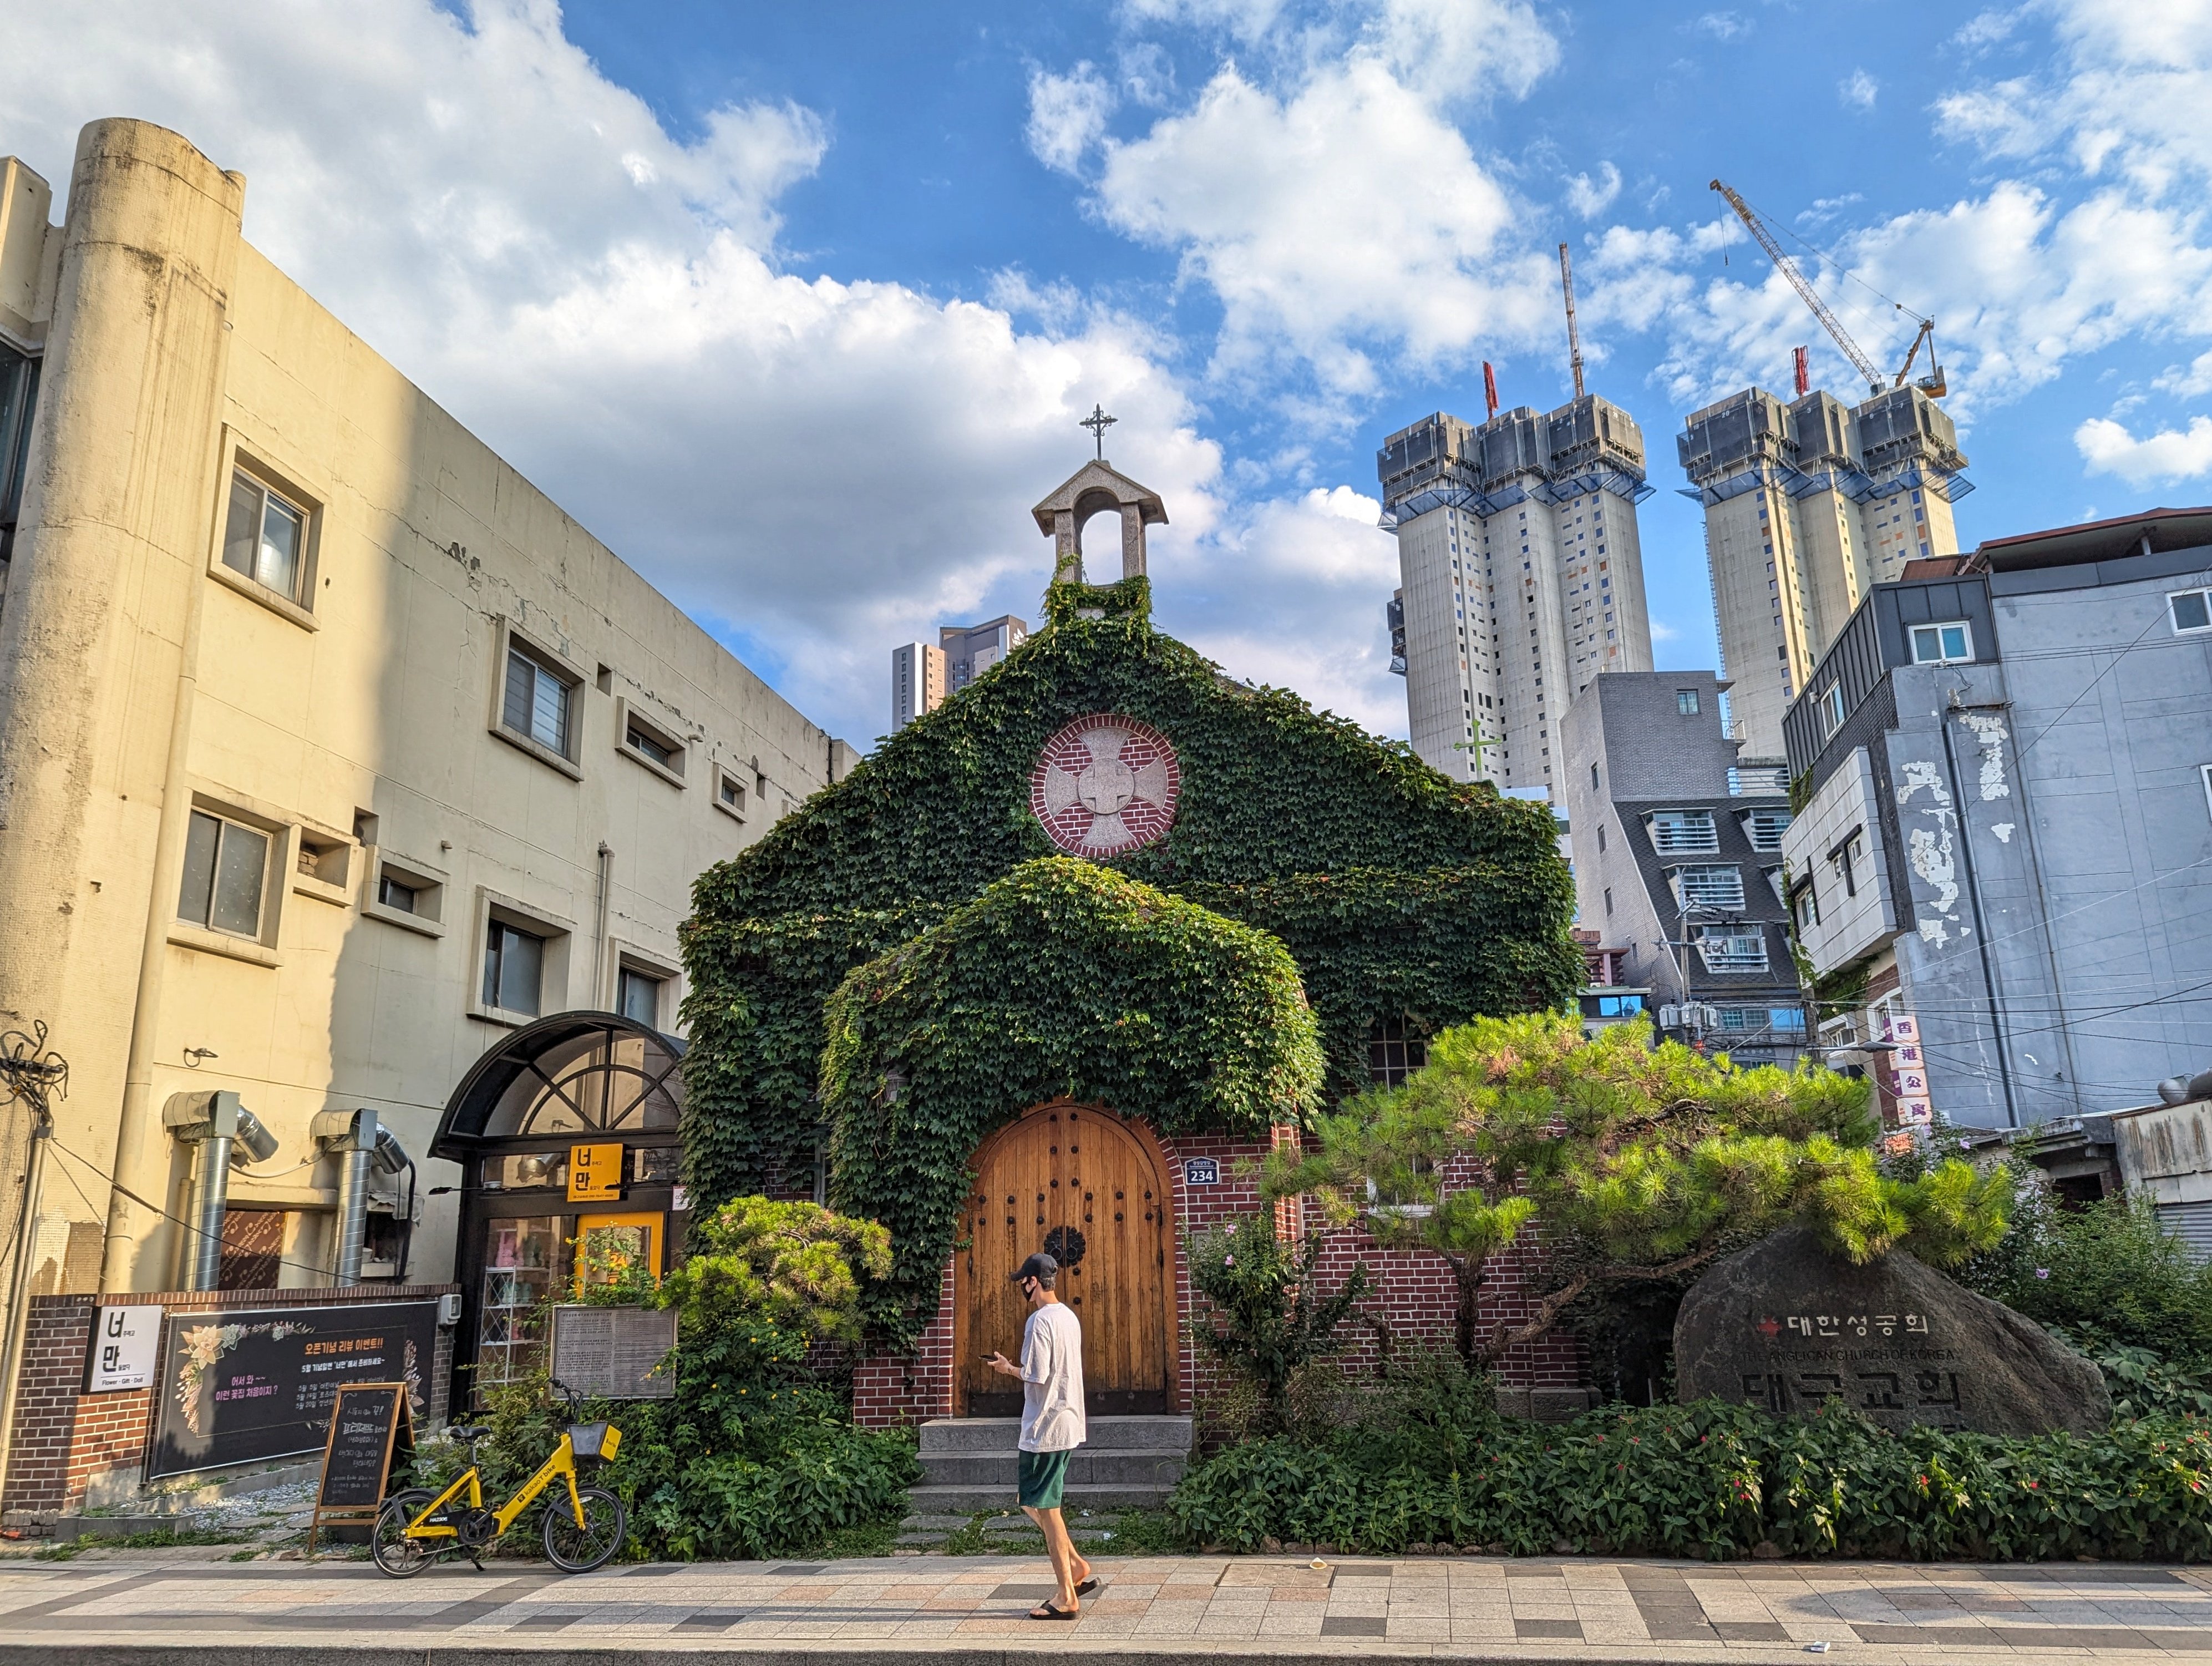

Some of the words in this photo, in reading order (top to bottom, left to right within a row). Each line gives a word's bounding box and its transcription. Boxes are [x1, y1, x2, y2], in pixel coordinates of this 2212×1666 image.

[577, 1148, 591, 1167] 너
[575, 1172, 590, 1191] 만
[1191, 1171, 1214, 1181] 234
[108, 1311, 126, 1338] 너
[1787, 1314, 1929, 1336] 대한성공회
[305, 1341, 337, 1355] 오픈기념
[338, 1340, 354, 1353] 리뷰
[356, 1337, 384, 1351] 이벤트!!
[103, 1345, 120, 1373] 만
[1742, 1351, 1768, 1362] THE
[1769, 1350, 1833, 1363] ANGLICAN
[1835, 1350, 1888, 1361] CHURCH
[1890, 1350, 1910, 1361] OF
[1910, 1349, 1955, 1361] KOREA
[301, 1364, 311, 1373] 5월
[231, 1376, 245, 1386] 어서
[246, 1375, 254, 1385] 와
[298, 1384, 307, 1392] 5월
[216, 1390, 230, 1401] 이런
[231, 1388, 245, 1400] 꽃집
[246, 1386, 272, 1397] 처음이지
[296, 1393, 305, 1401] 5월
[1742, 1370, 1962, 1414] 대구교회
[524, 1479, 541, 1495] kakao
[542, 1464, 556, 1477] bike
